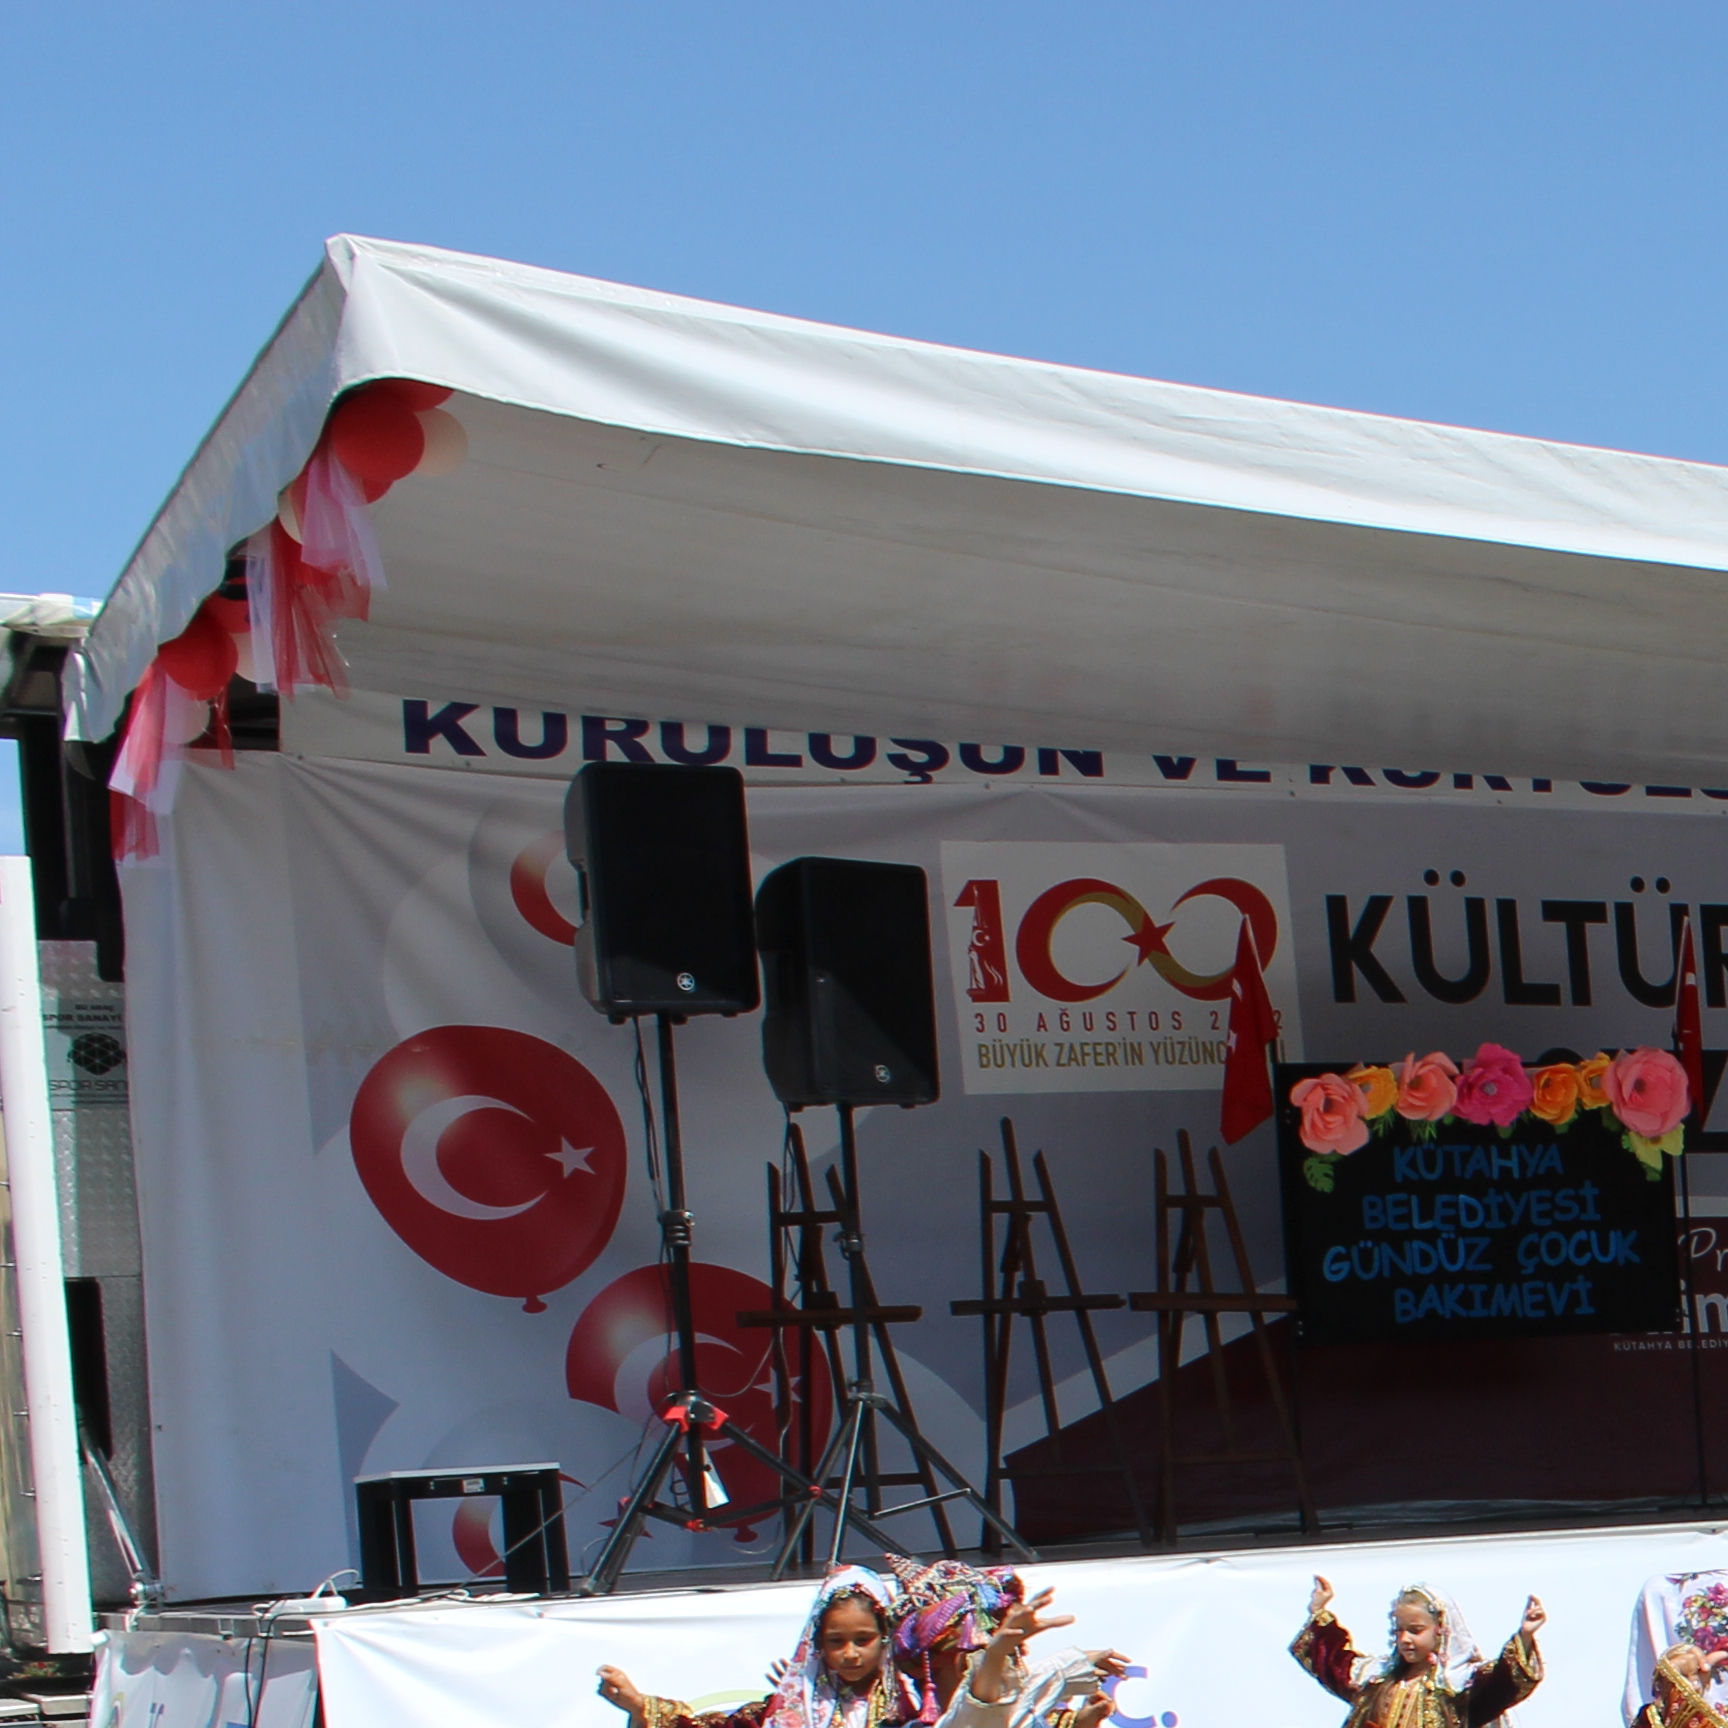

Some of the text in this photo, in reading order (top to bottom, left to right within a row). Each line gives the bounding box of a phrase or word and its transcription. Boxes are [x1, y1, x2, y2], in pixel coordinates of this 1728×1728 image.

[974, 1012, 1008, 1033] 30
[1036, 1008, 1183, 1032] AĞUSTOS
[977, 1039, 1049, 1068] BÜYÜK
[1149, 1037, 1228, 1066] YÜZÜNC
[1393, 1142, 1564, 1182] KÜTAHYA
[1361, 1180, 1603, 1231] BELEDİYESİ
[1322, 1230, 1641, 1282] GÜNDÜZ ÇOCUK
[1393, 1274, 1596, 1323] BAKIMEVİ
